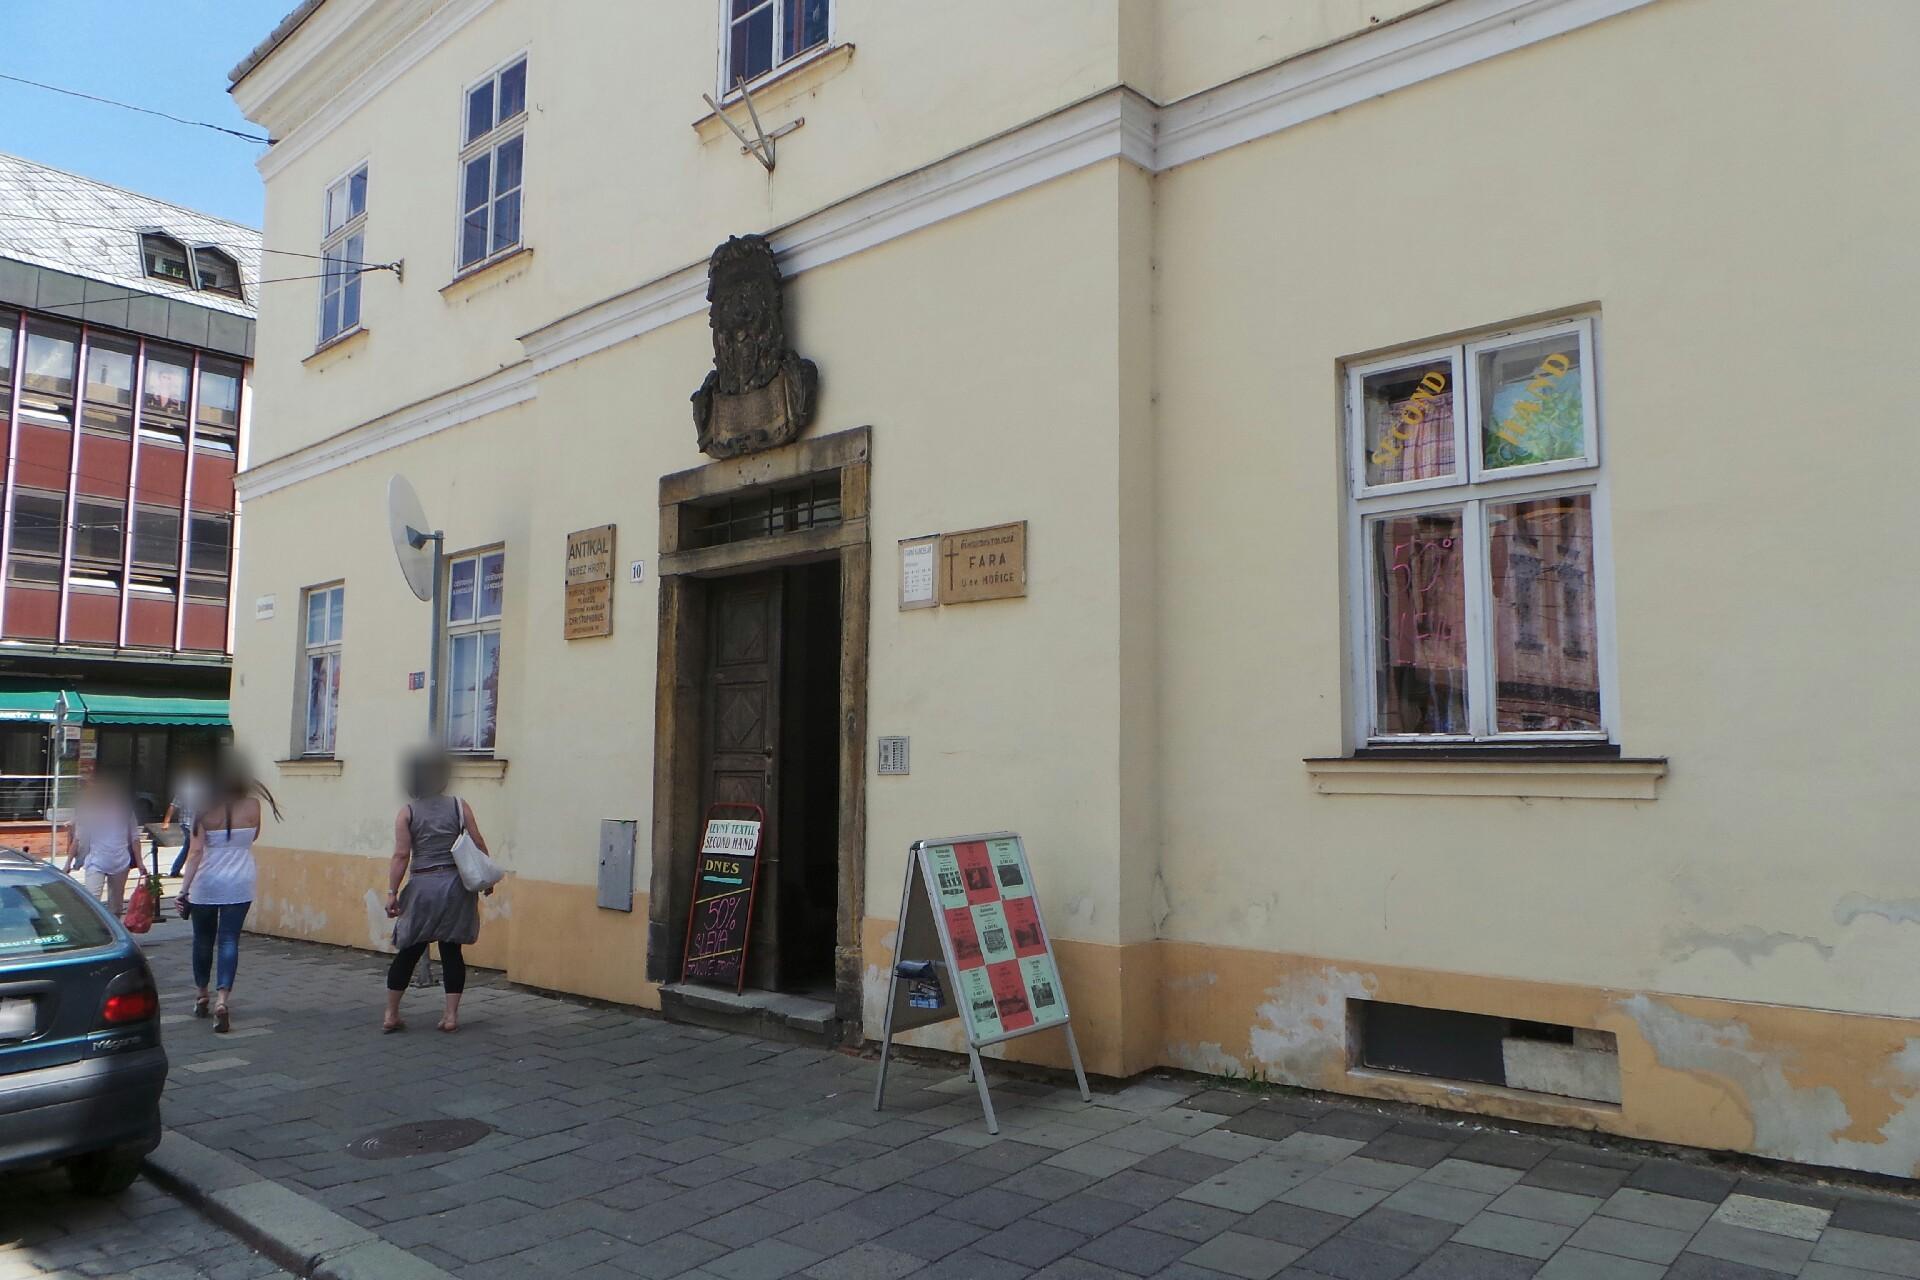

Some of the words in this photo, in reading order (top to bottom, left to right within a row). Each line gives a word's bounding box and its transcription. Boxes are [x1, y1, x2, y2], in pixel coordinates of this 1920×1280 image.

[568, 538, 609, 561] ANTIKAL
[969, 552, 1007, 569] FARA
[633, 564, 642, 579] 10
[709, 822, 730, 835] LEVNÝ
[731, 824, 756, 836] TEXTIL
[704, 836, 731, 849] SECOND
[732, 838, 754, 851] HAND
[705, 859, 740, 874] DNES
[704, 897, 741, 930] 50%
